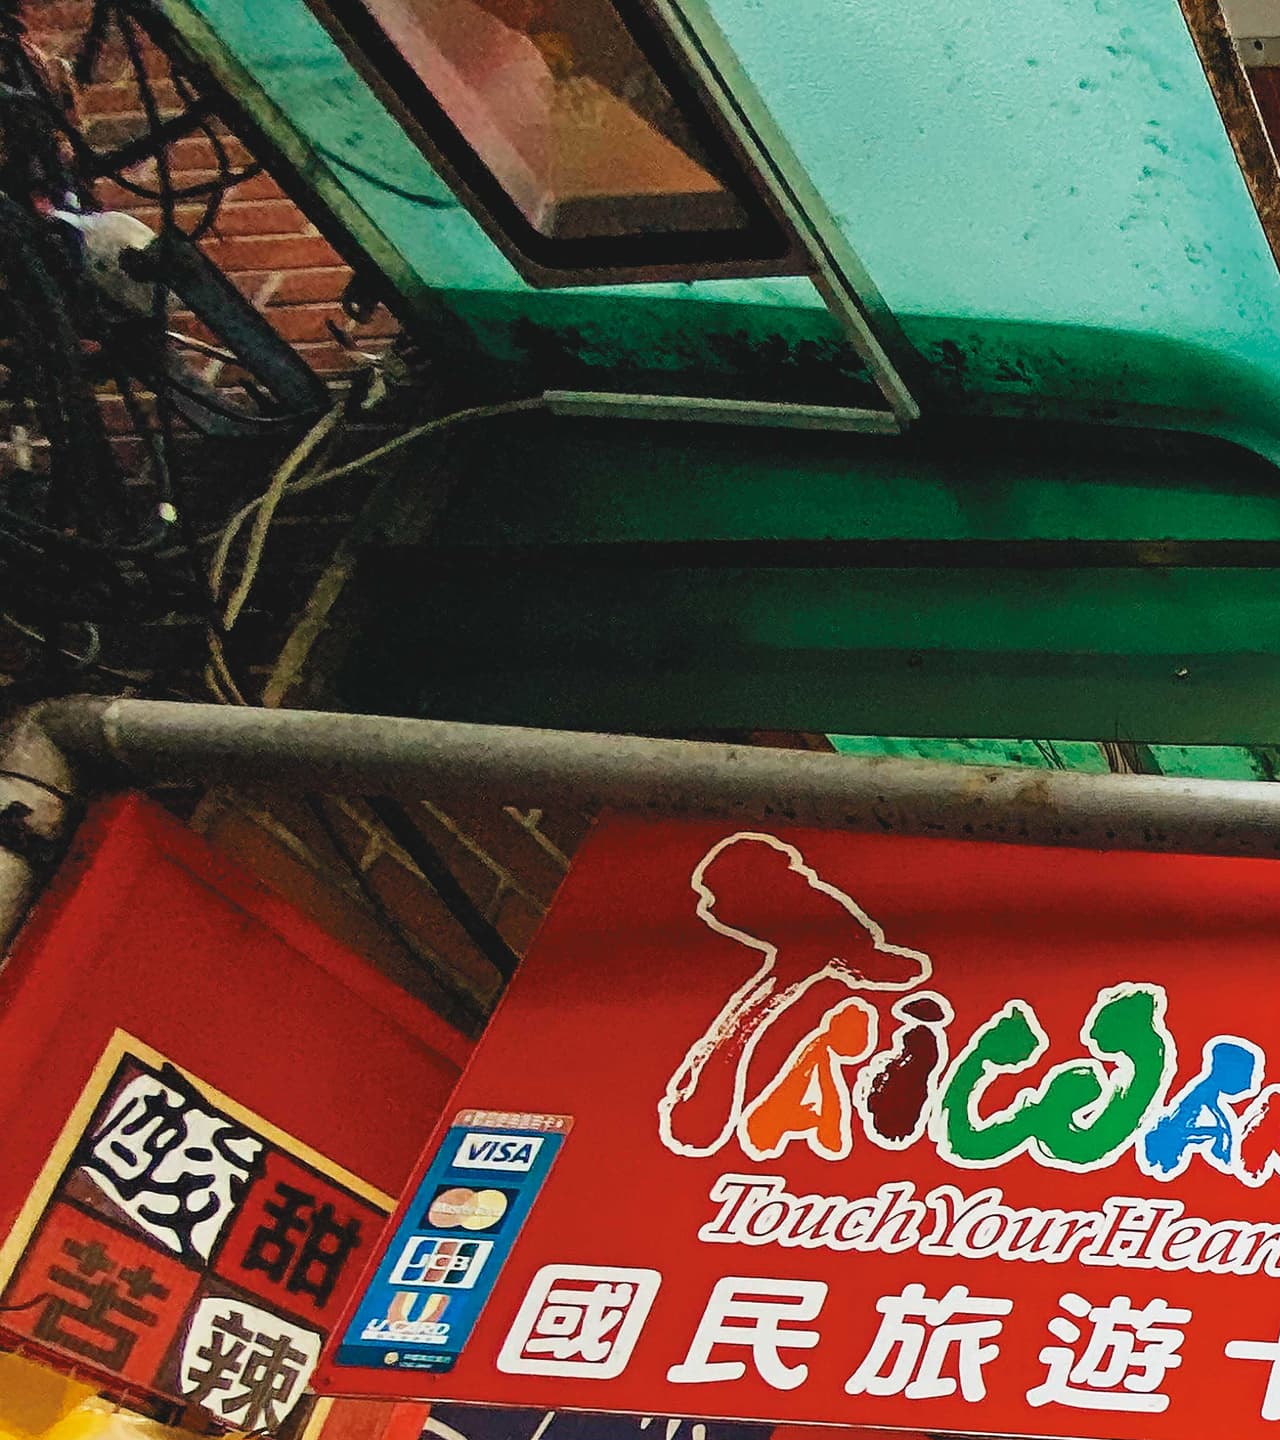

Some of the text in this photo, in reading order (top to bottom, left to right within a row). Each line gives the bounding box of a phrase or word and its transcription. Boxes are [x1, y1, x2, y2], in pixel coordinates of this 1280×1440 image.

[469, 1140, 533, 1164] VISA
[698, 1173, 940, 1256] Touch
[928, 1190, 1098, 1262] Your
